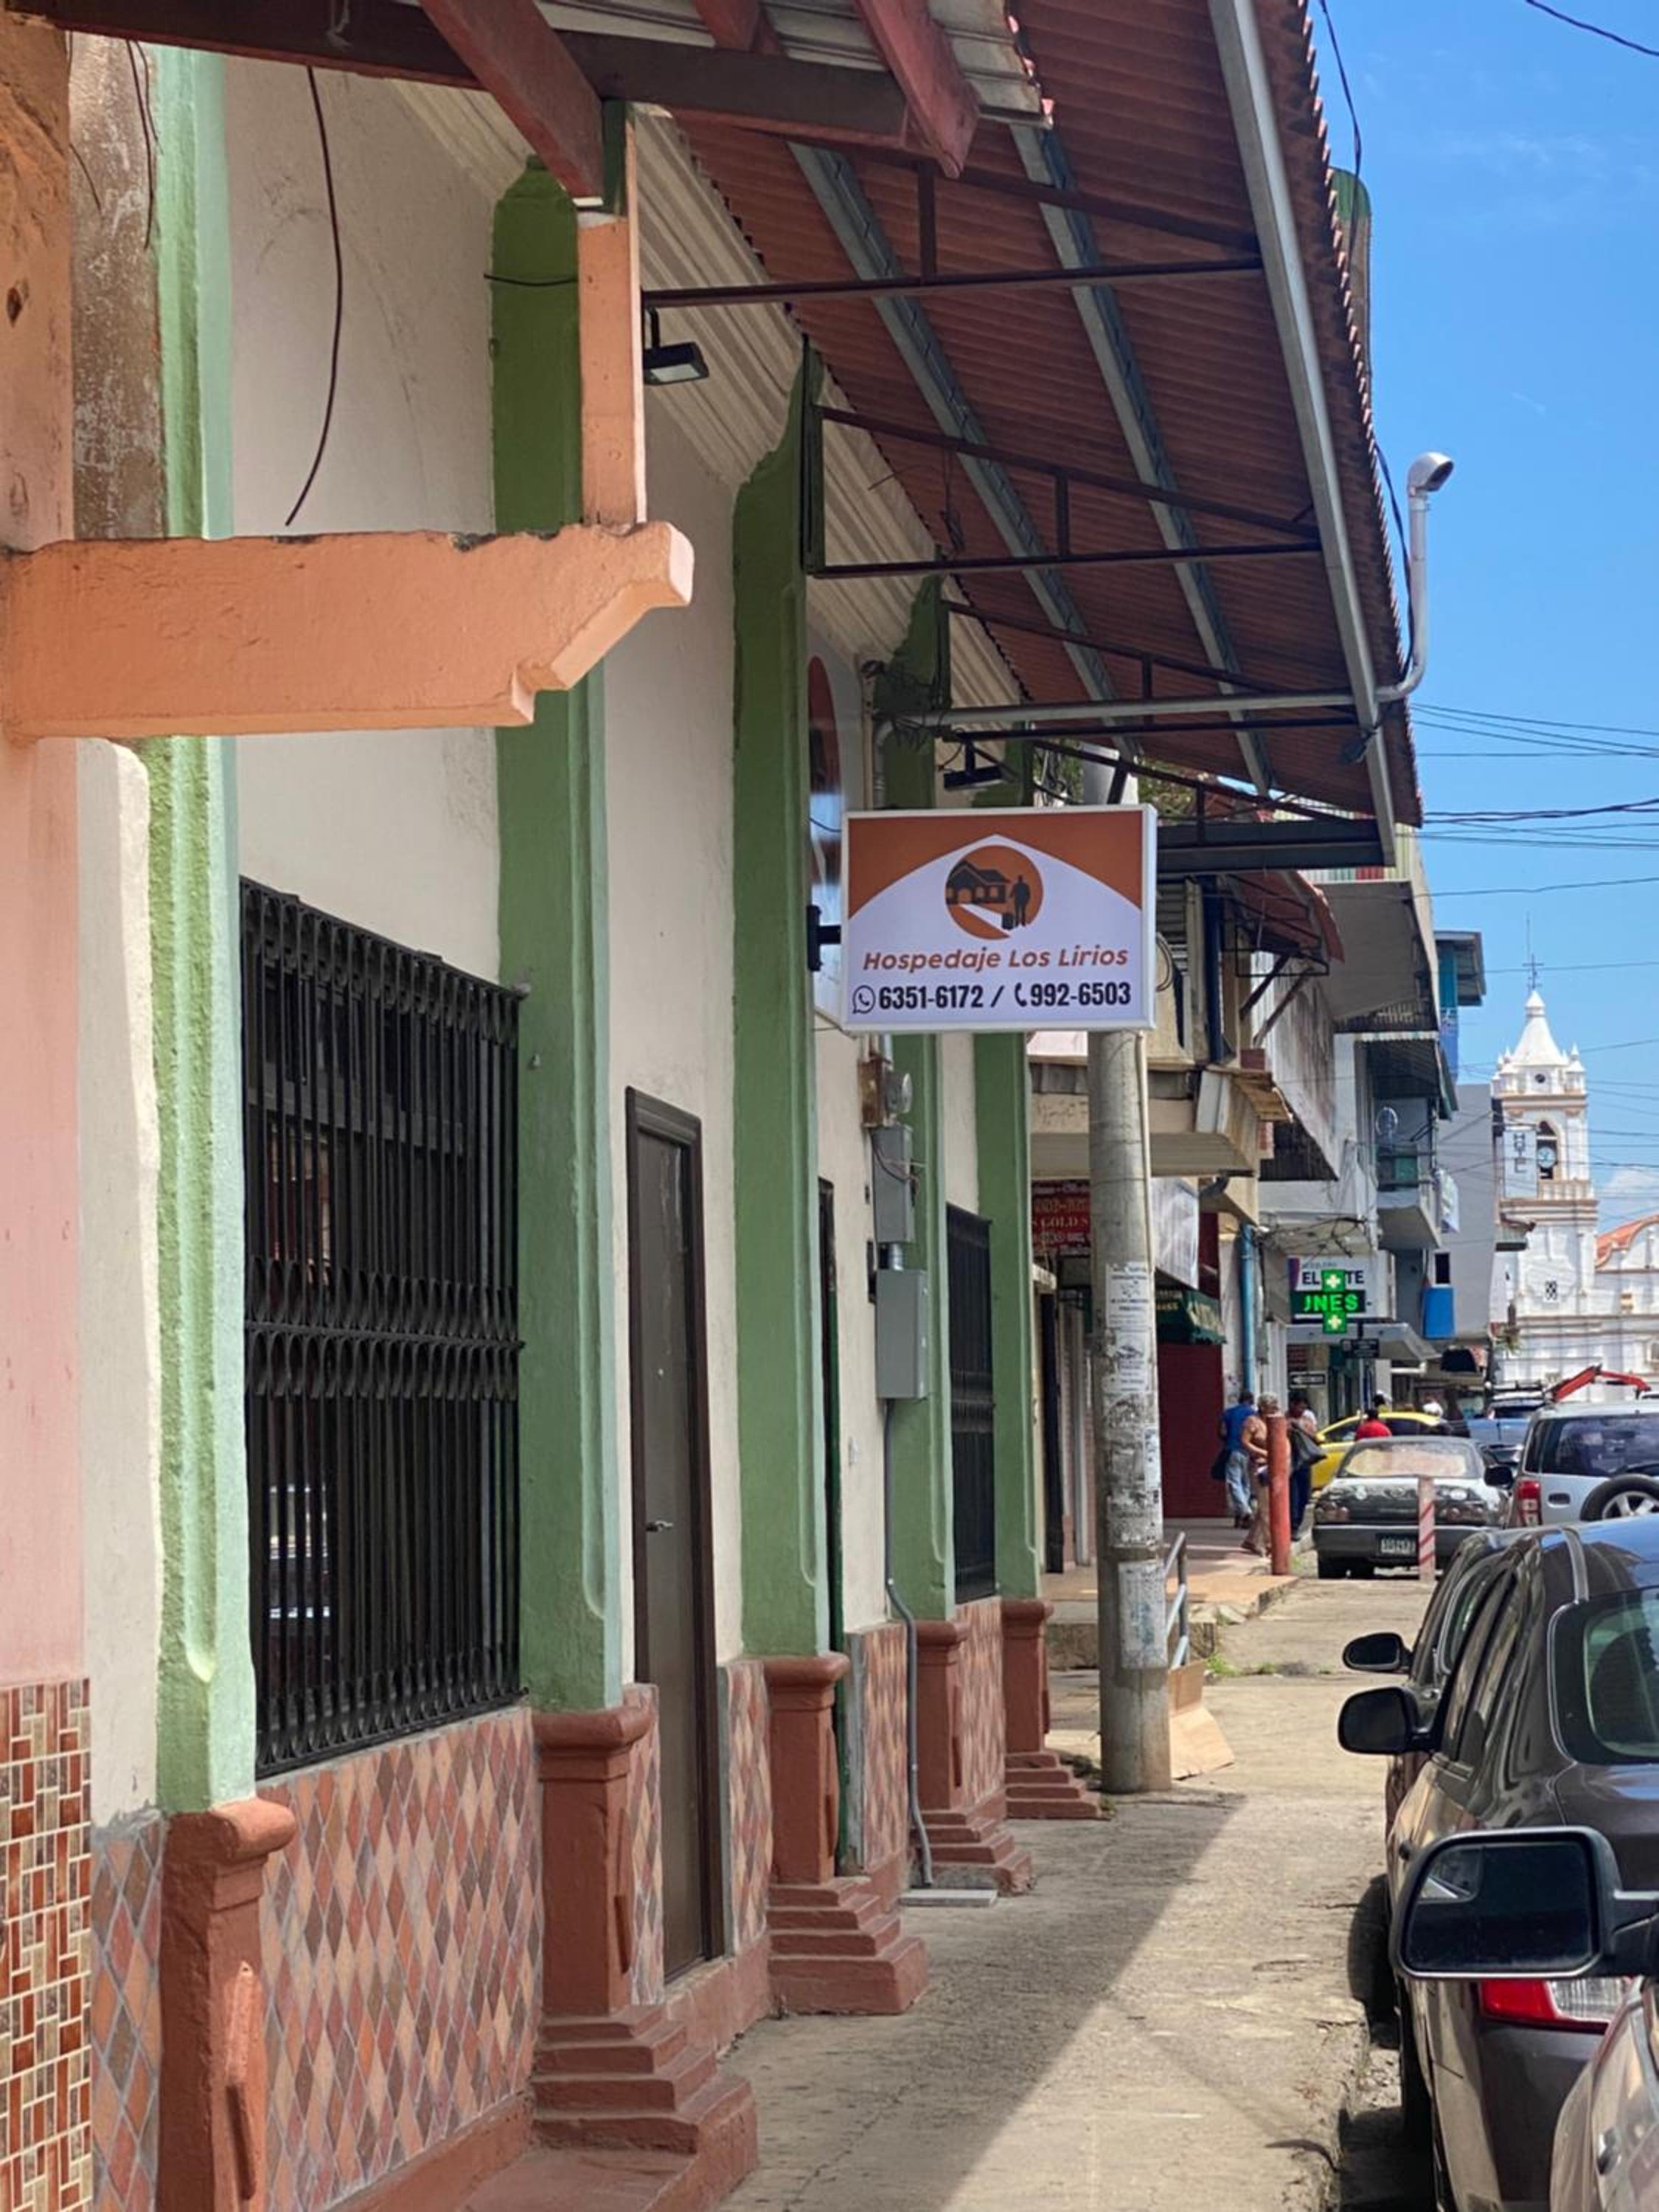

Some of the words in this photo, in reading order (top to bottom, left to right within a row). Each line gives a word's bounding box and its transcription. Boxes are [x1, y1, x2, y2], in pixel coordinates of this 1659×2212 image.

[863, 947, 1001, 973] Hospedaje
[1009, 948, 1051, 967] Los
[1058, 945, 1129, 967] Lirios
[878, 984, 984, 1009] 6351-6172
[990, 984, 1005, 1007] /
[1031, 981, 1131, 1006] 992-6503
